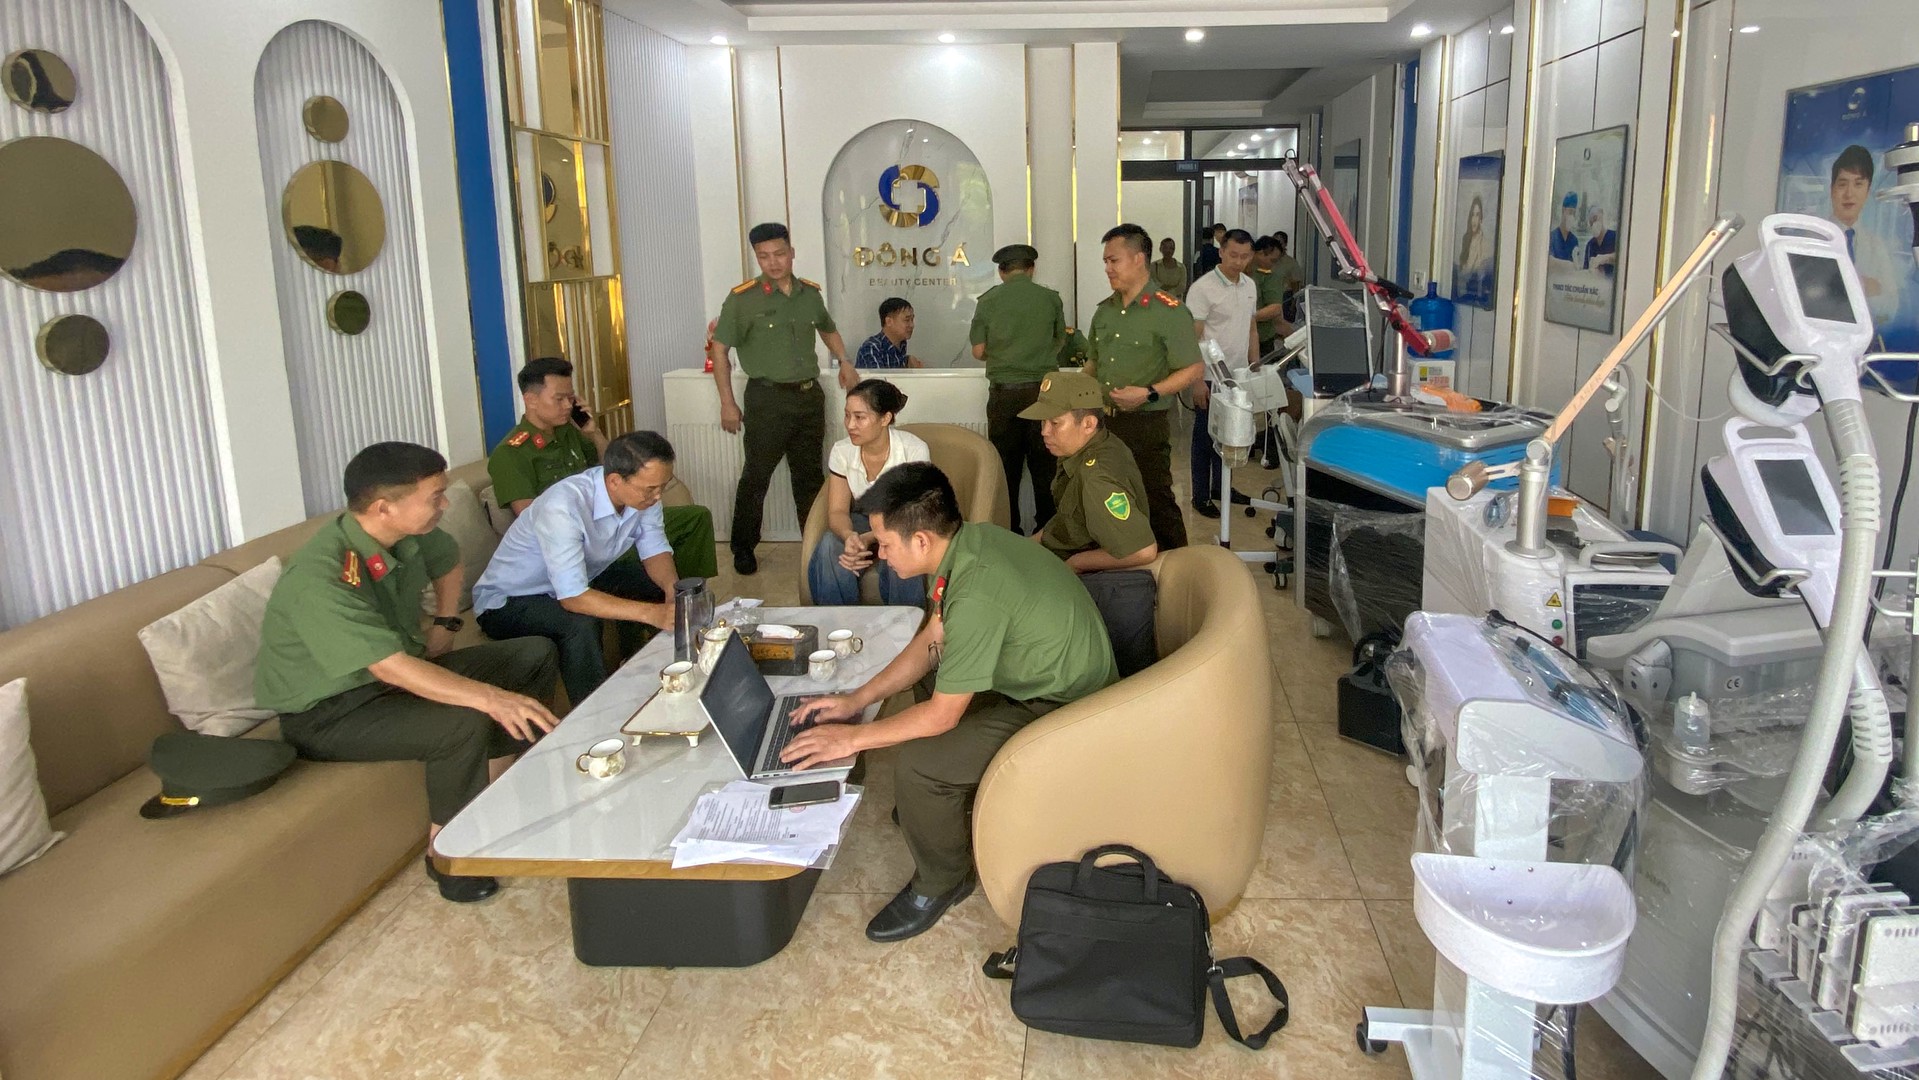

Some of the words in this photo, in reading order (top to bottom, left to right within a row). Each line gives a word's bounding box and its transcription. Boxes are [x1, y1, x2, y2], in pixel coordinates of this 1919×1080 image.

[853, 242, 942, 268] ĐÔNG
[950, 242, 970, 267] Á
[869, 279, 911, 287] BEAUTY
[914, 278, 957, 287] CENTER
[1726, 678, 1740, 690] CE
